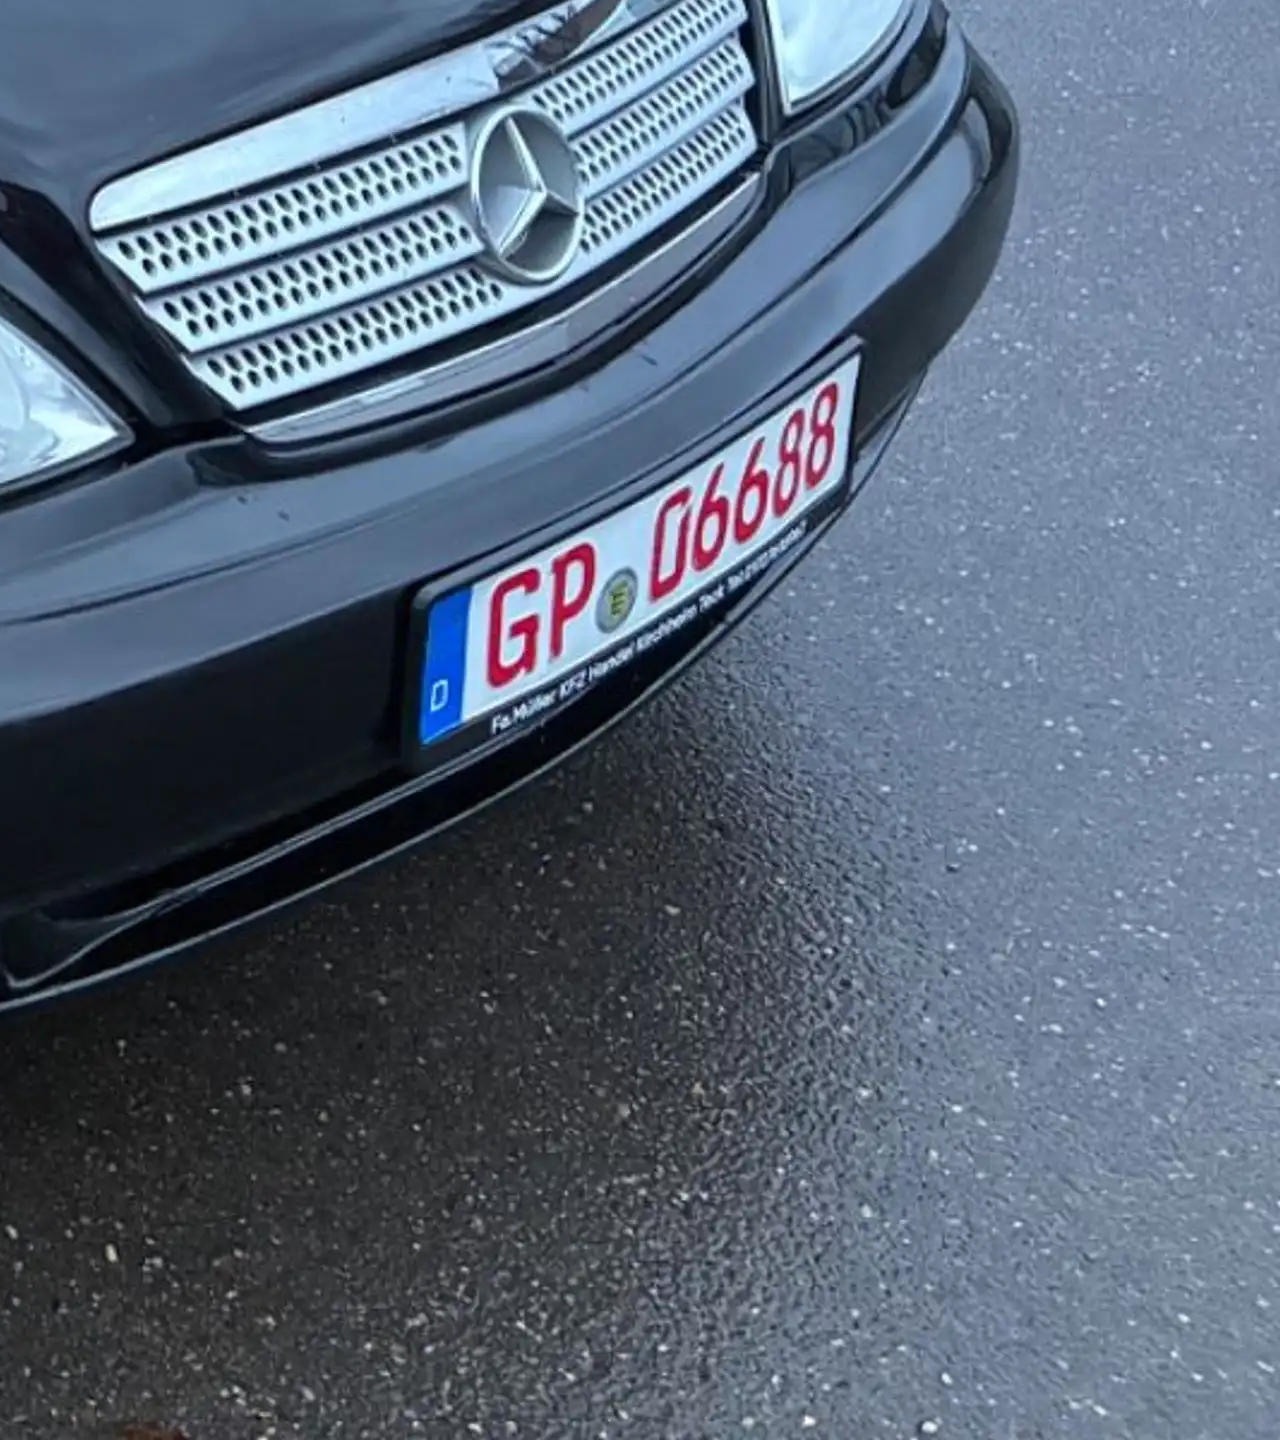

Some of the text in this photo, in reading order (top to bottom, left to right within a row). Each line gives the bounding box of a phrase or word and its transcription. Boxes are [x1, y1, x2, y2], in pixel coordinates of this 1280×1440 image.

[430, 678, 449, 712] D
[486, 541, 596, 690] GP
[648, 381, 838, 604] 06688
